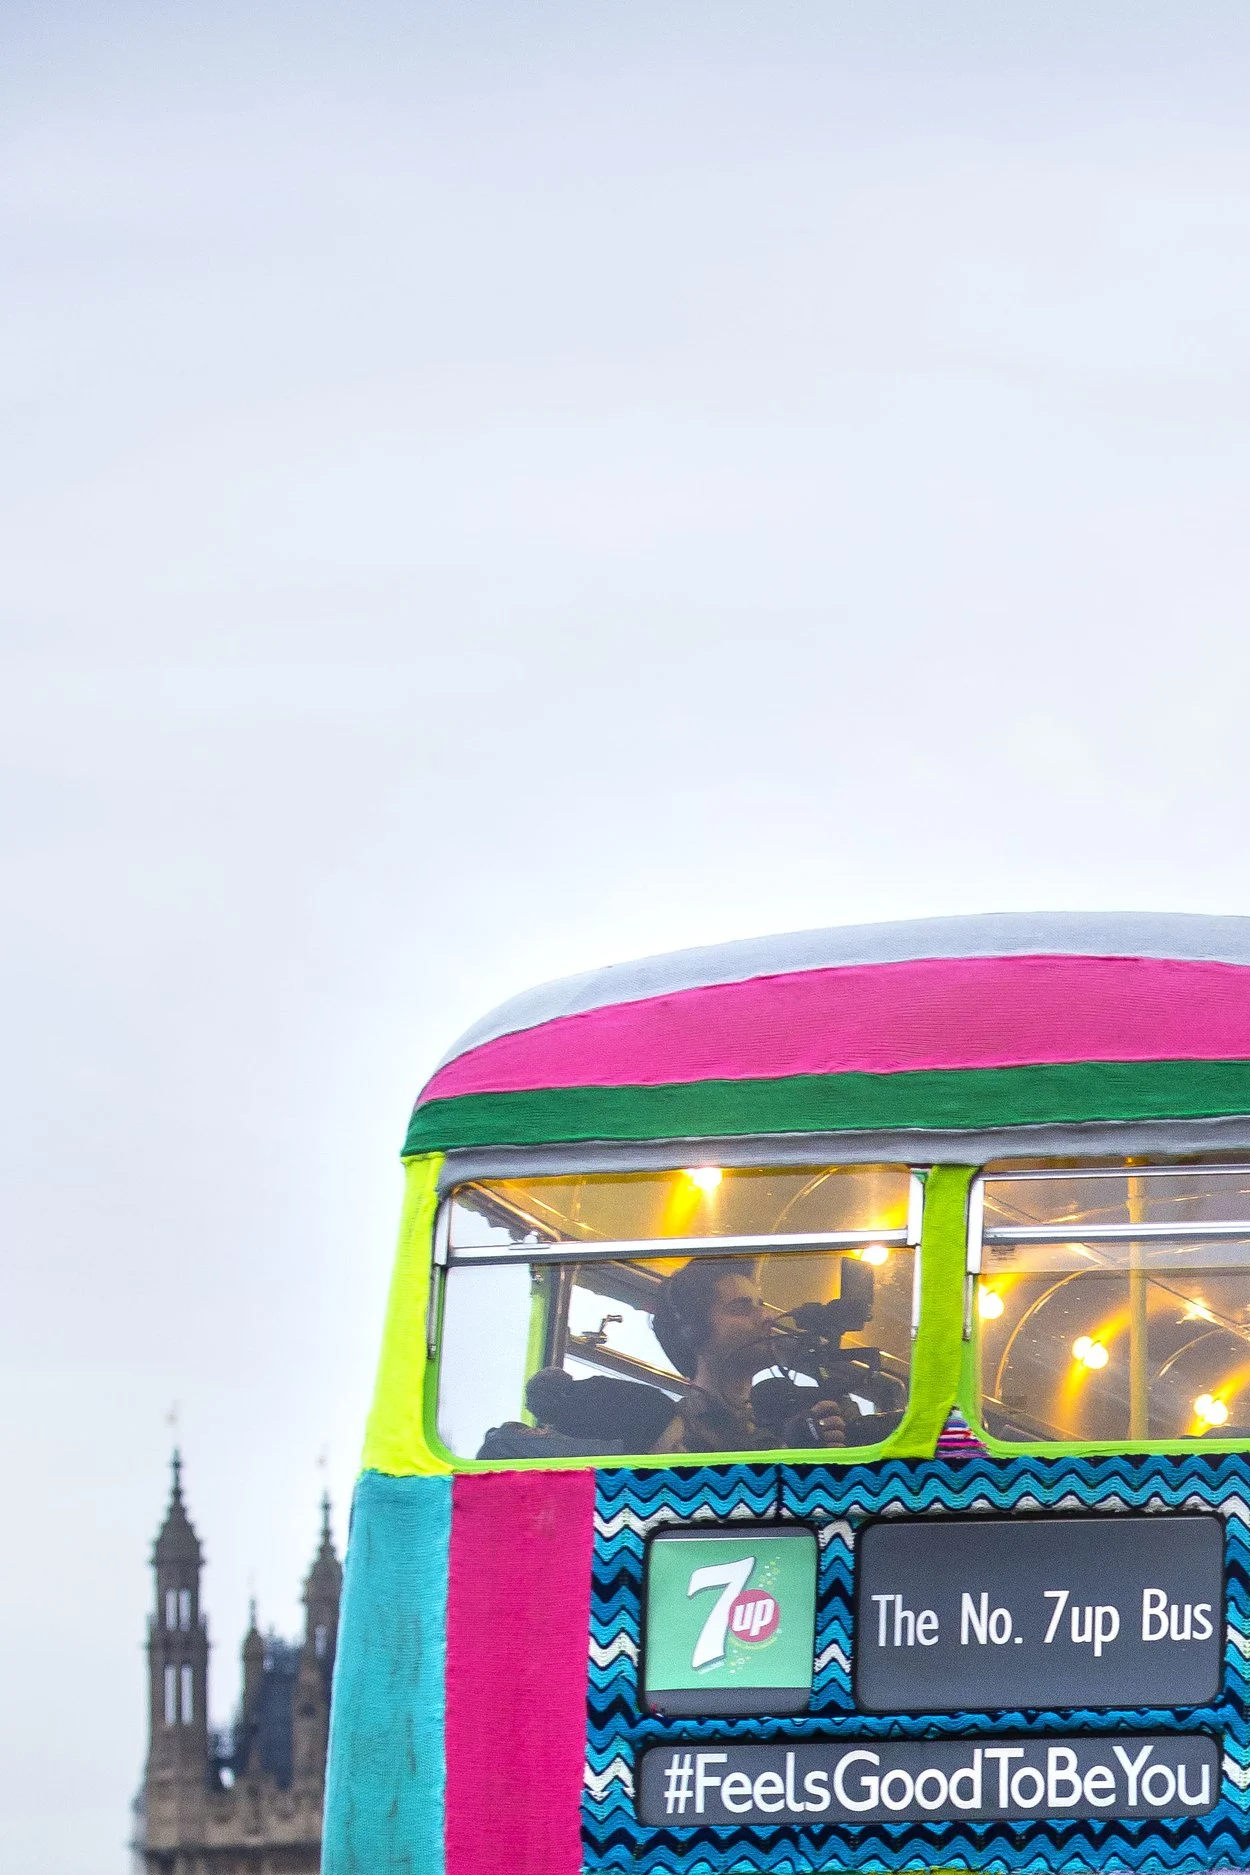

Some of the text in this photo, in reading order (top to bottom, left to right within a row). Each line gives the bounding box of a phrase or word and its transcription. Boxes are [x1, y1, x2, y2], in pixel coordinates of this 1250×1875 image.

[871, 1588, 1214, 1657] The No. 7up Bus
[663, 1744, 1210, 1815] #FeelsGoodToBeYou
